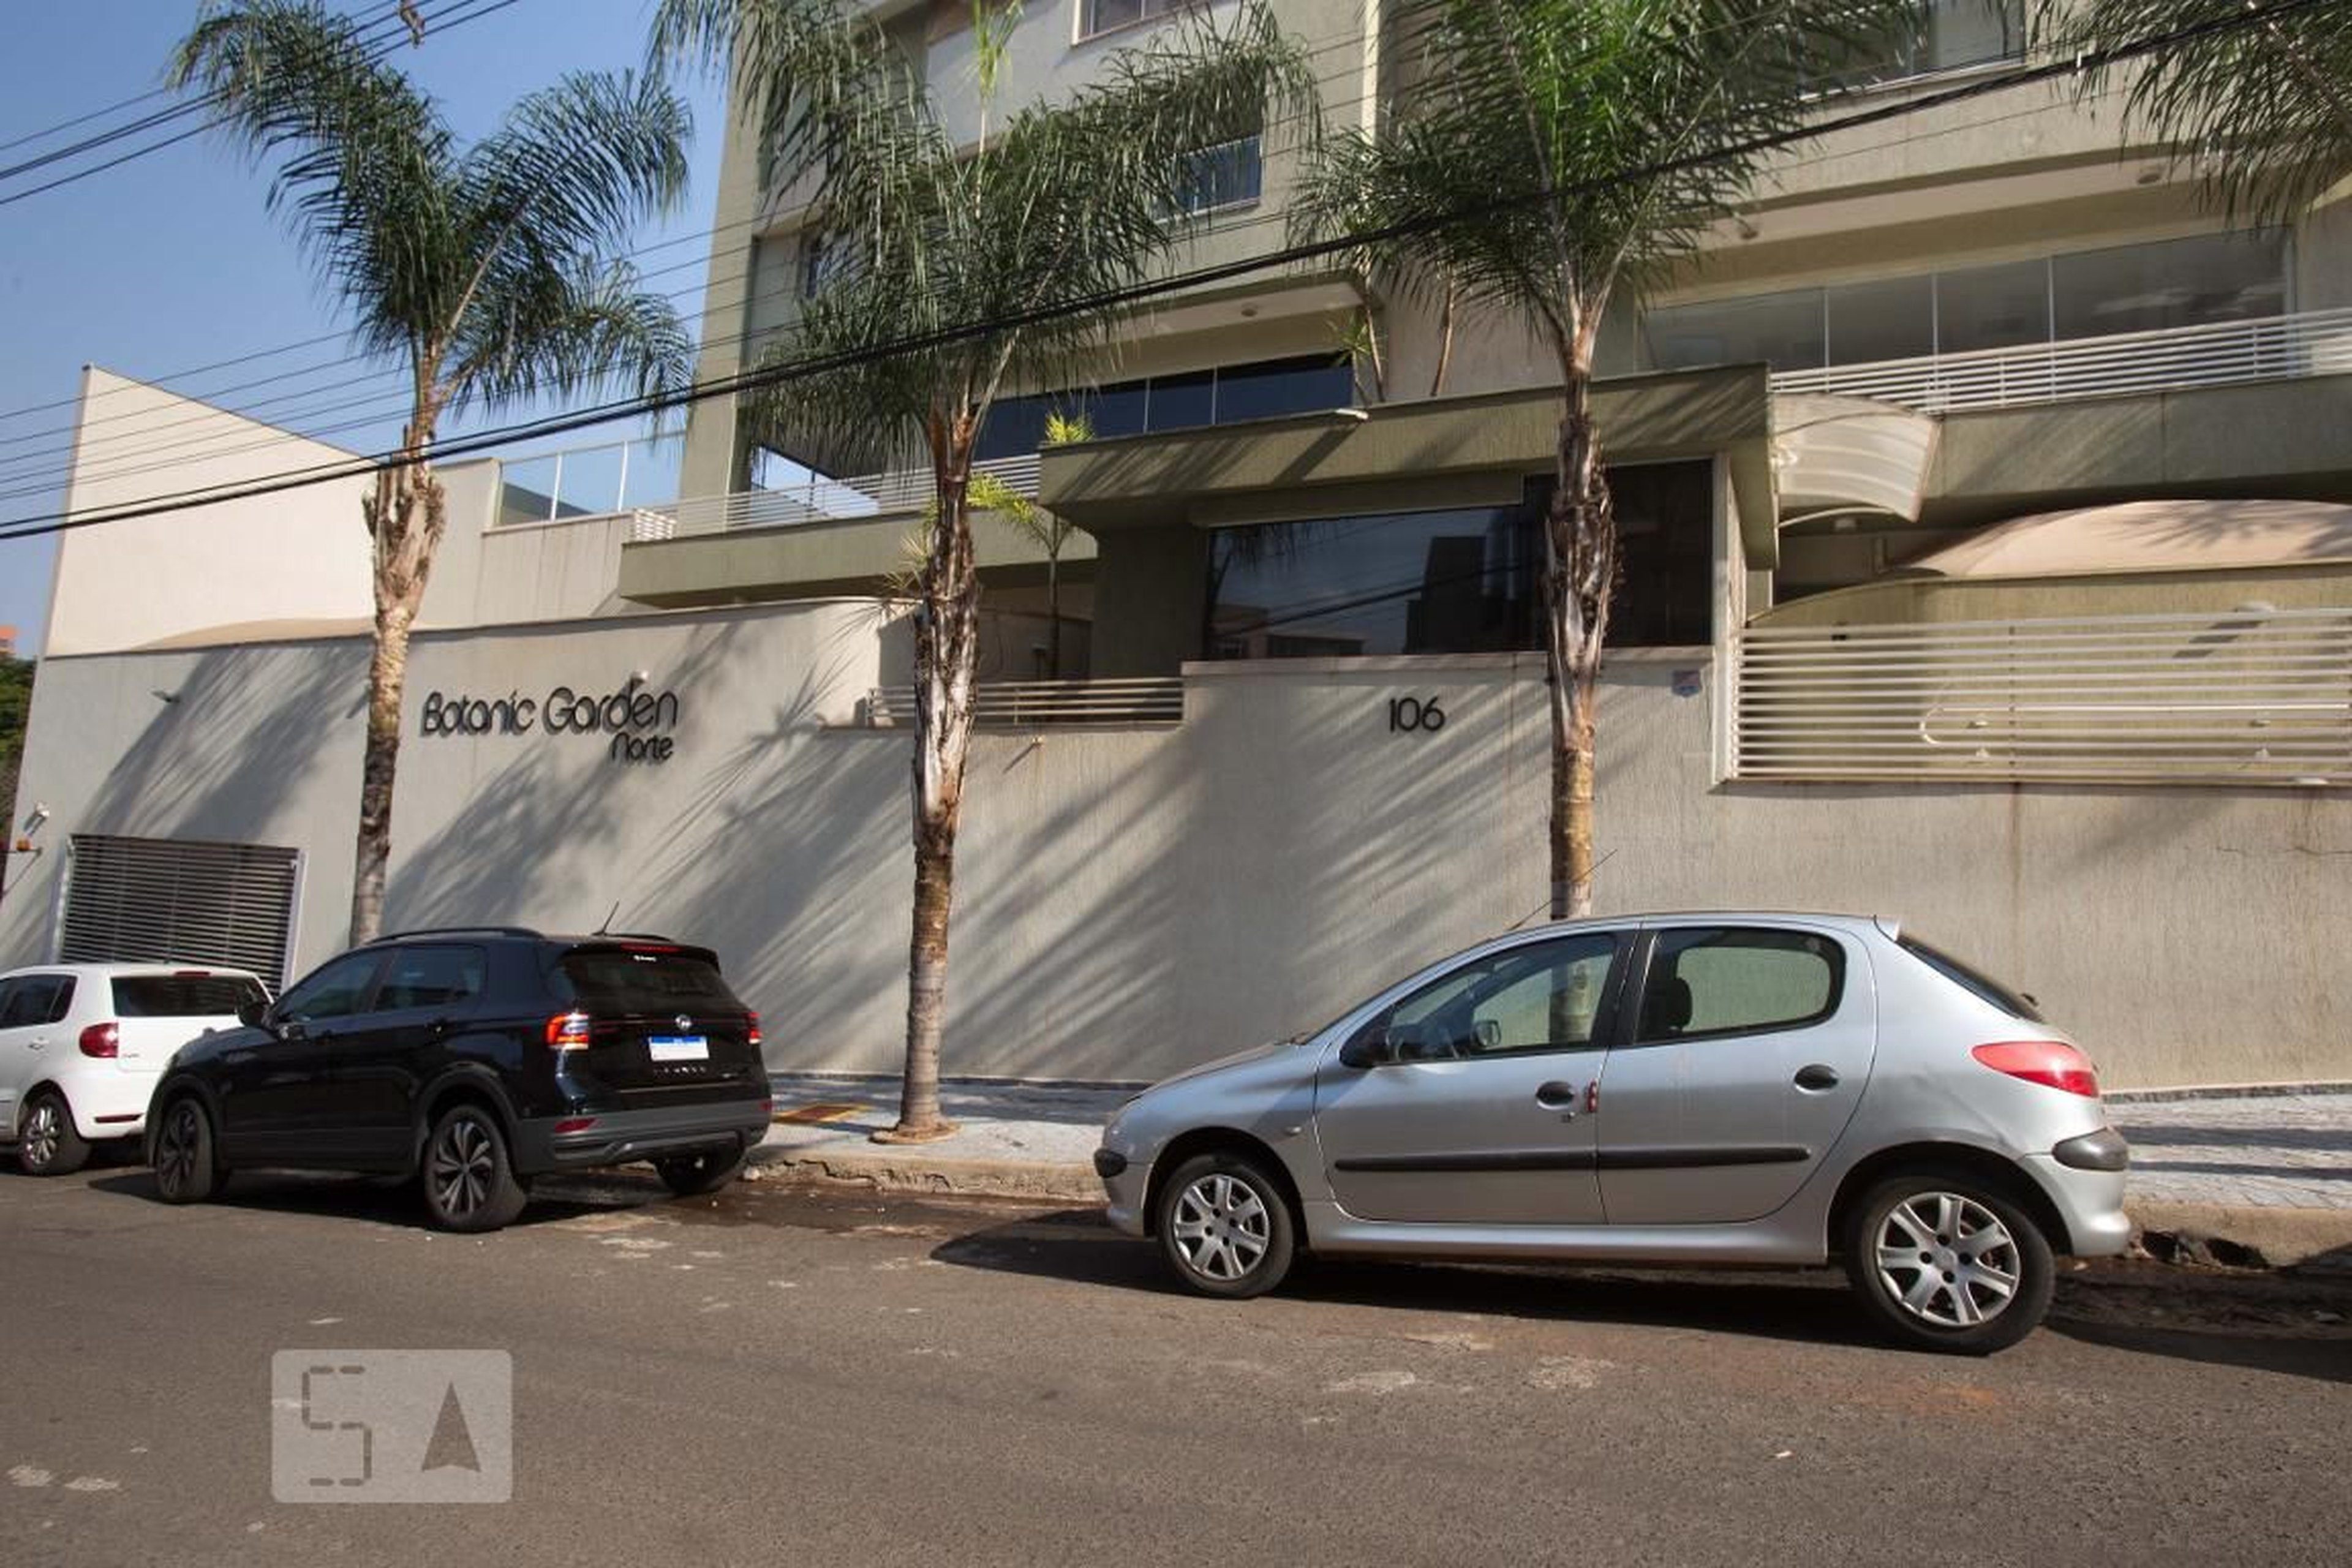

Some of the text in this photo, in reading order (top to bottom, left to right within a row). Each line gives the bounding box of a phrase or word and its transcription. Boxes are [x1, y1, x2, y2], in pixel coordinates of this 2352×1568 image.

[423, 677, 678, 733] Botanic Garden
[1389, 696, 1445, 732] 106
